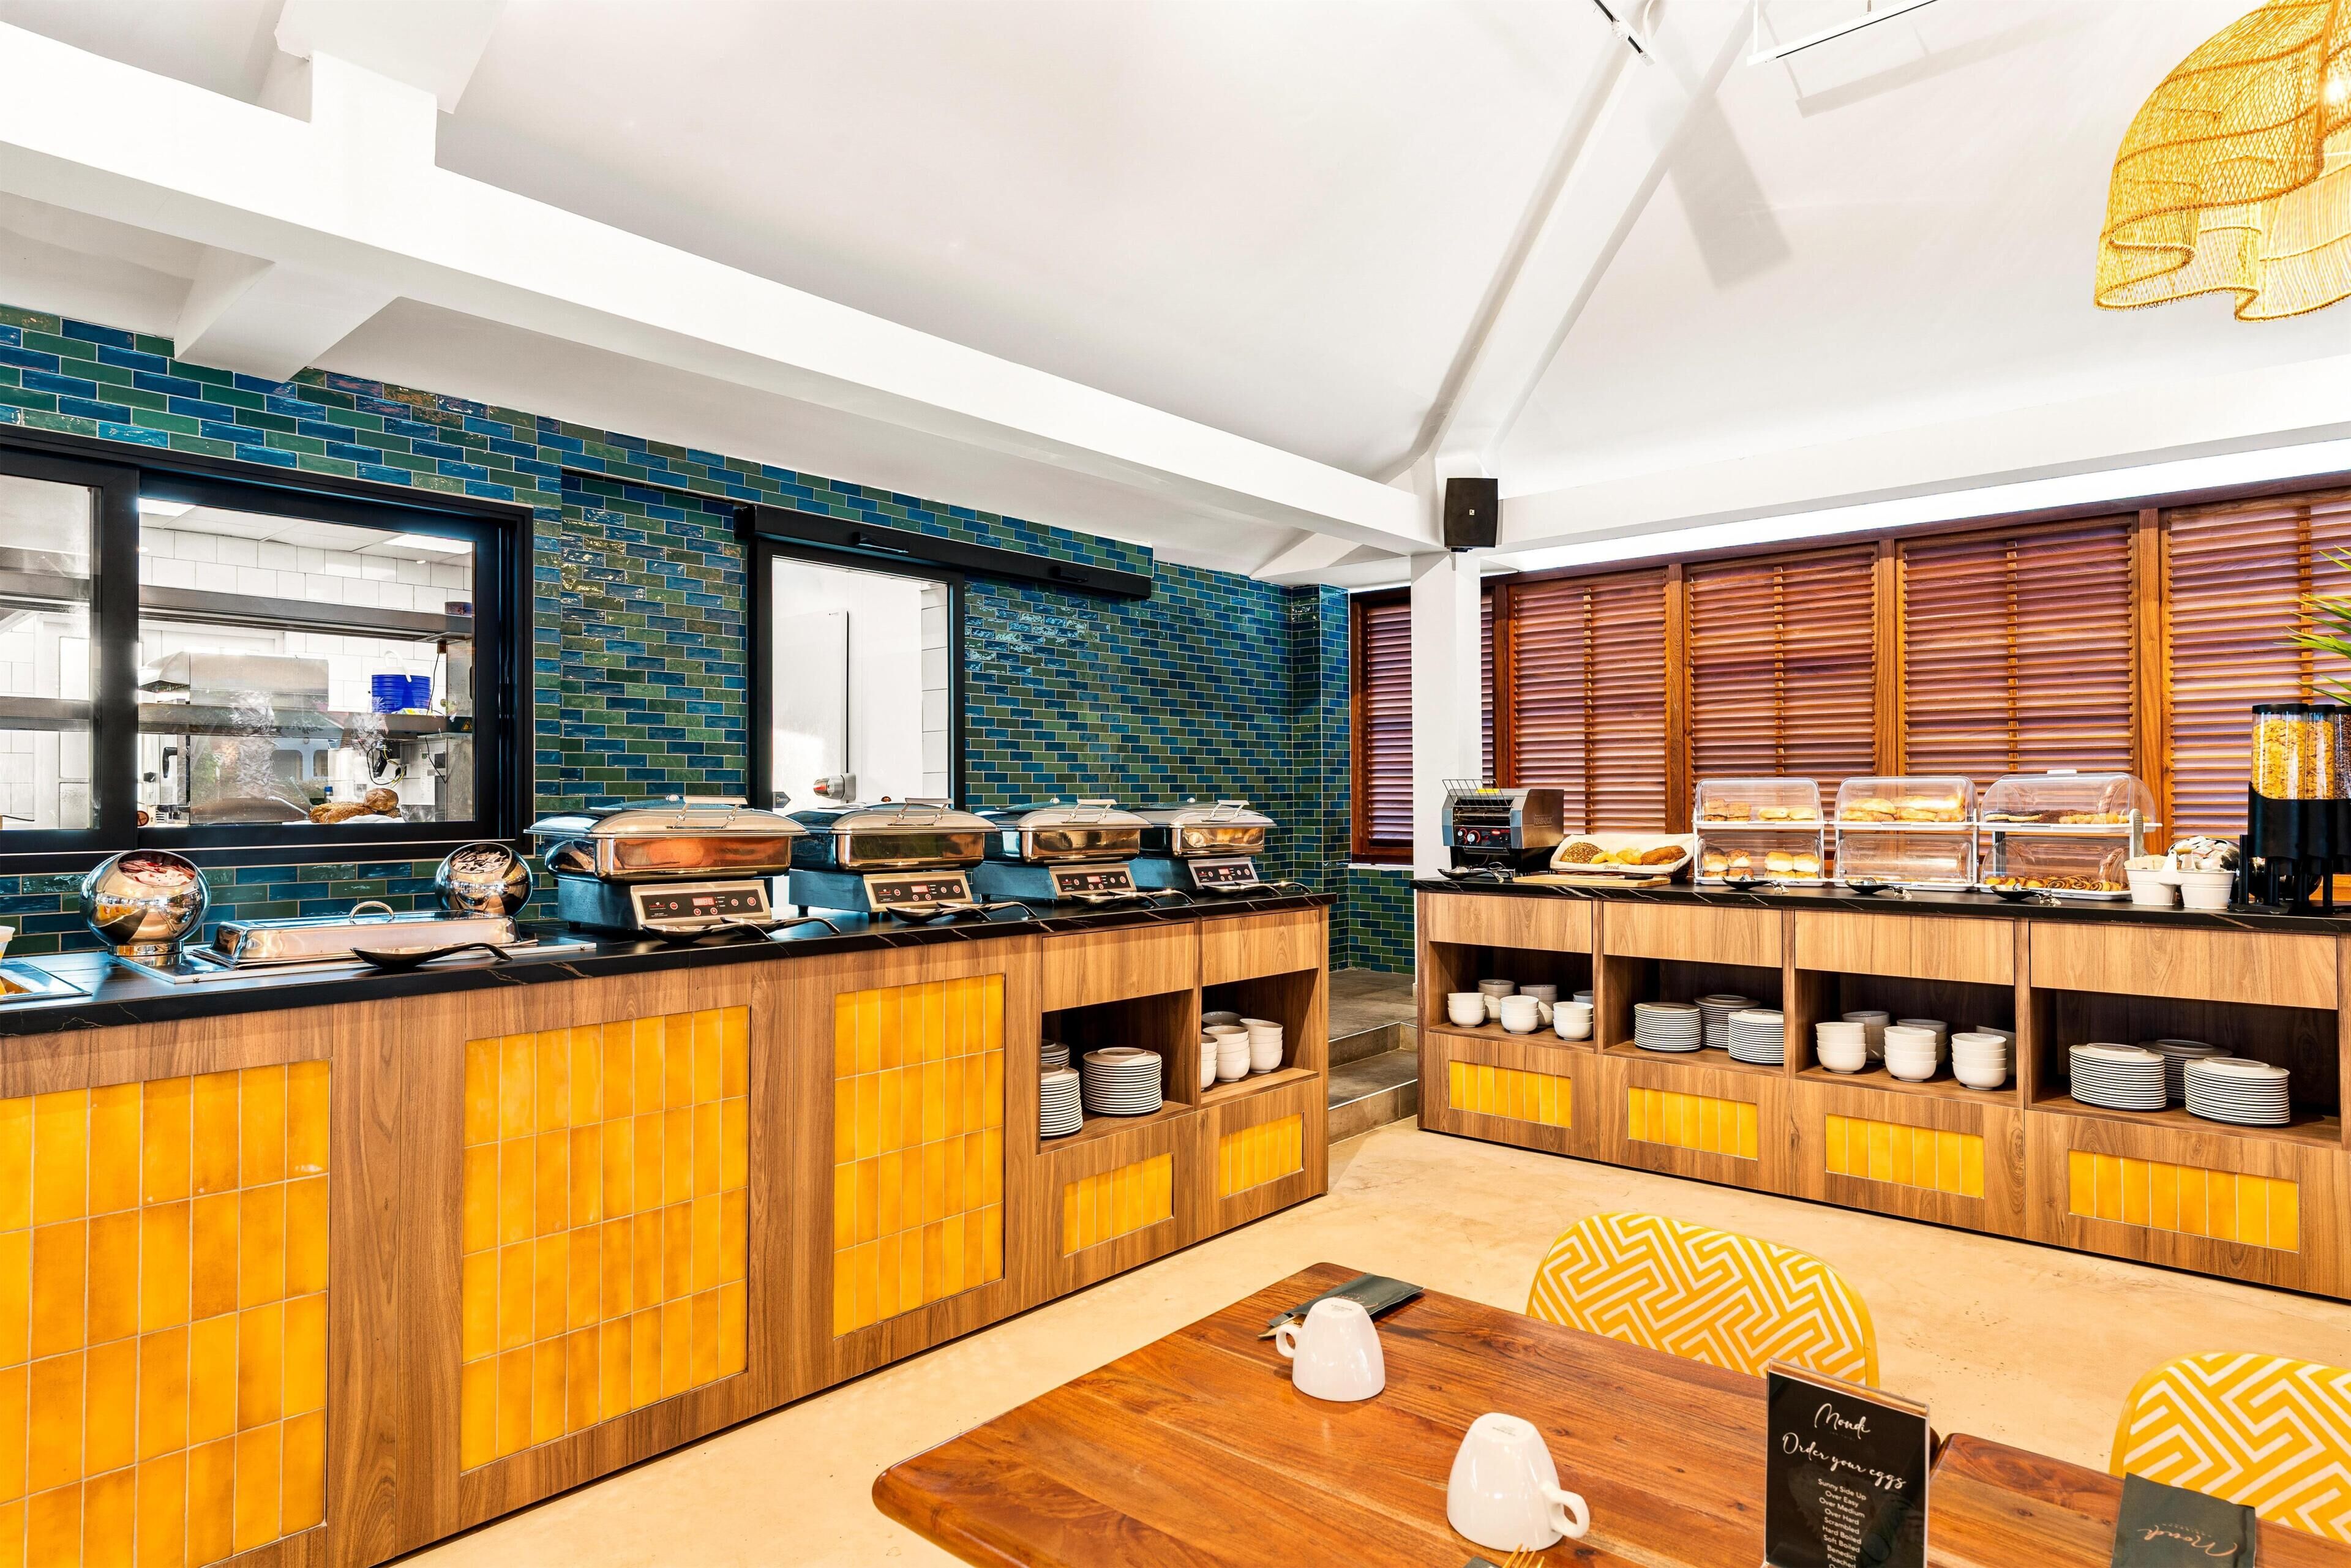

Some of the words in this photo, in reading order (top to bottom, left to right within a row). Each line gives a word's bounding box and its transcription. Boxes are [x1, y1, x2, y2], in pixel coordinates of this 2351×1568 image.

[1782, 1432, 1829, 1461] Order
[1830, 1456, 1867, 1472] your
[1869, 1469, 1907, 1490] eggs
[1818, 1478, 1838, 1491] Sunny
[1839, 1485, 1855, 1497] Side
[1856, 1491, 1867, 1501] Up
[1819, 1497, 1836, 1507] Over
[1837, 1502, 1865, 1518] Medium
[1825, 1490, 1842, 1501] Over
[1843, 1496, 1859, 1508] Easy
[1824, 1508, 1842, 1518] Over
[1842, 1514, 1859, 1526] Hard
[1824, 1517, 1860, 1535] Scrambled
[1822, 1525, 1839, 1536] Hard
[1840, 1531, 1862, 1545] Boiled
[1823, 1534, 1837, 1545] Soft
[1839, 1540, 1860, 1553] Boiled
[1827, 1545, 1856, 1561] Benedict
[1827, 1553, 1856, 1568] Poached
